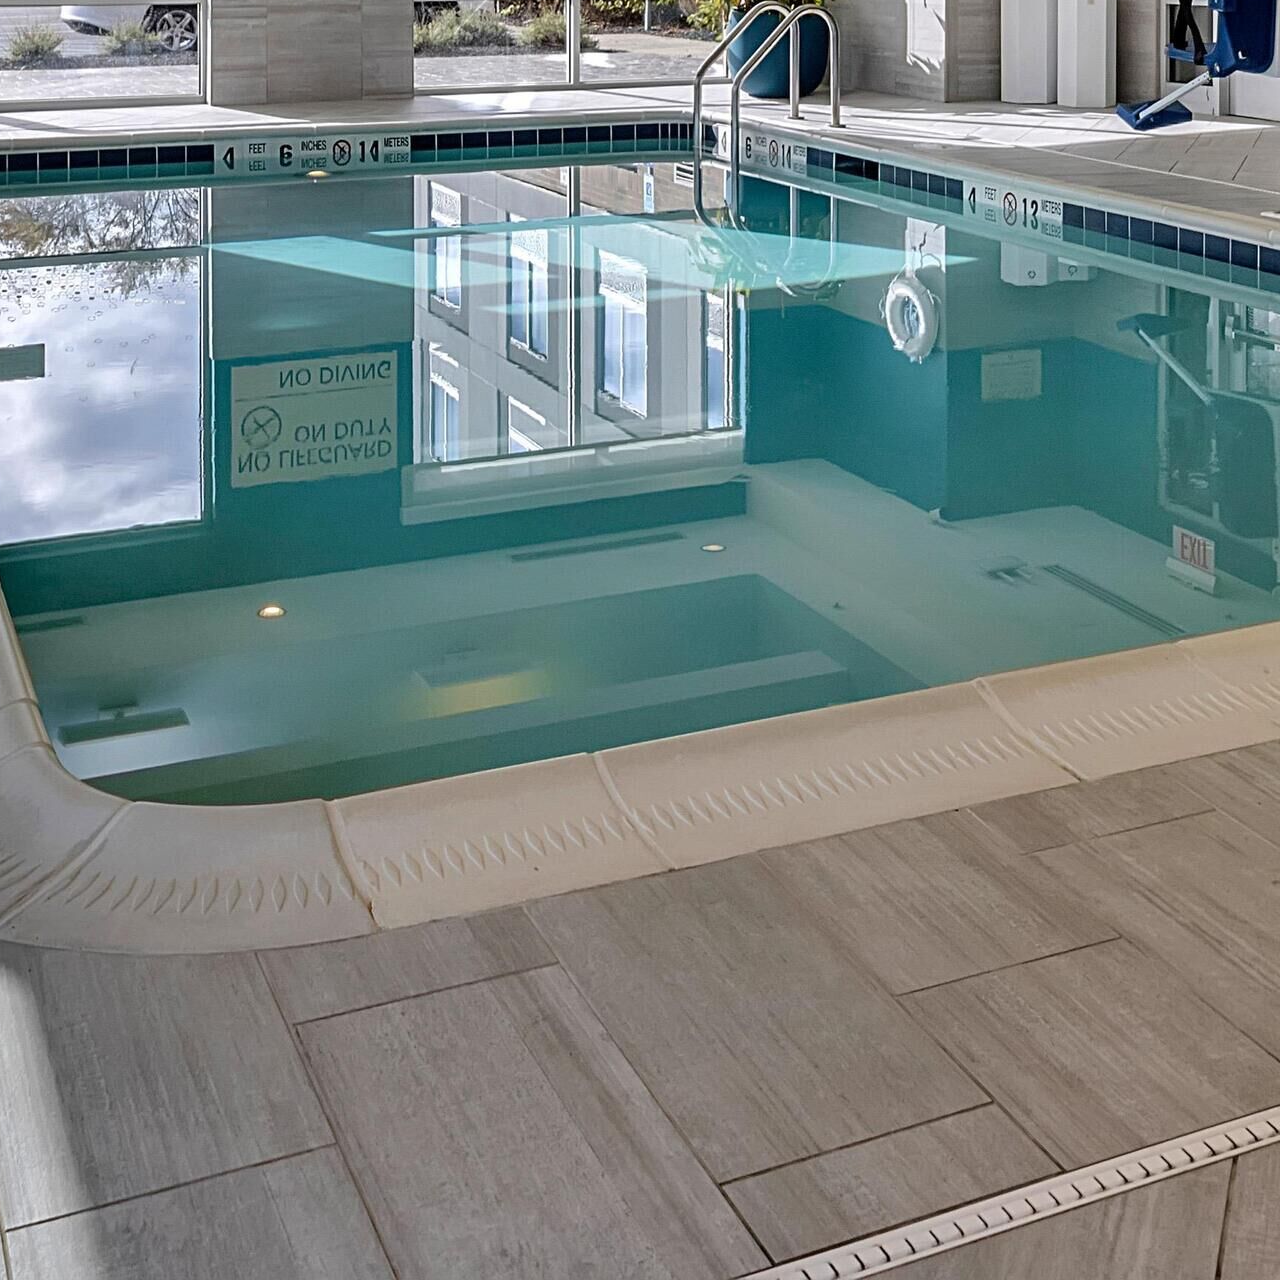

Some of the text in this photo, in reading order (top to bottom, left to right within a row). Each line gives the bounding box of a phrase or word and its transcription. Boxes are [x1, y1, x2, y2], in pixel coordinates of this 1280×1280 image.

[248, 143, 267, 154] FEET
[300, 140, 327, 151] INCHES
[383, 137, 409, 148] METERS
